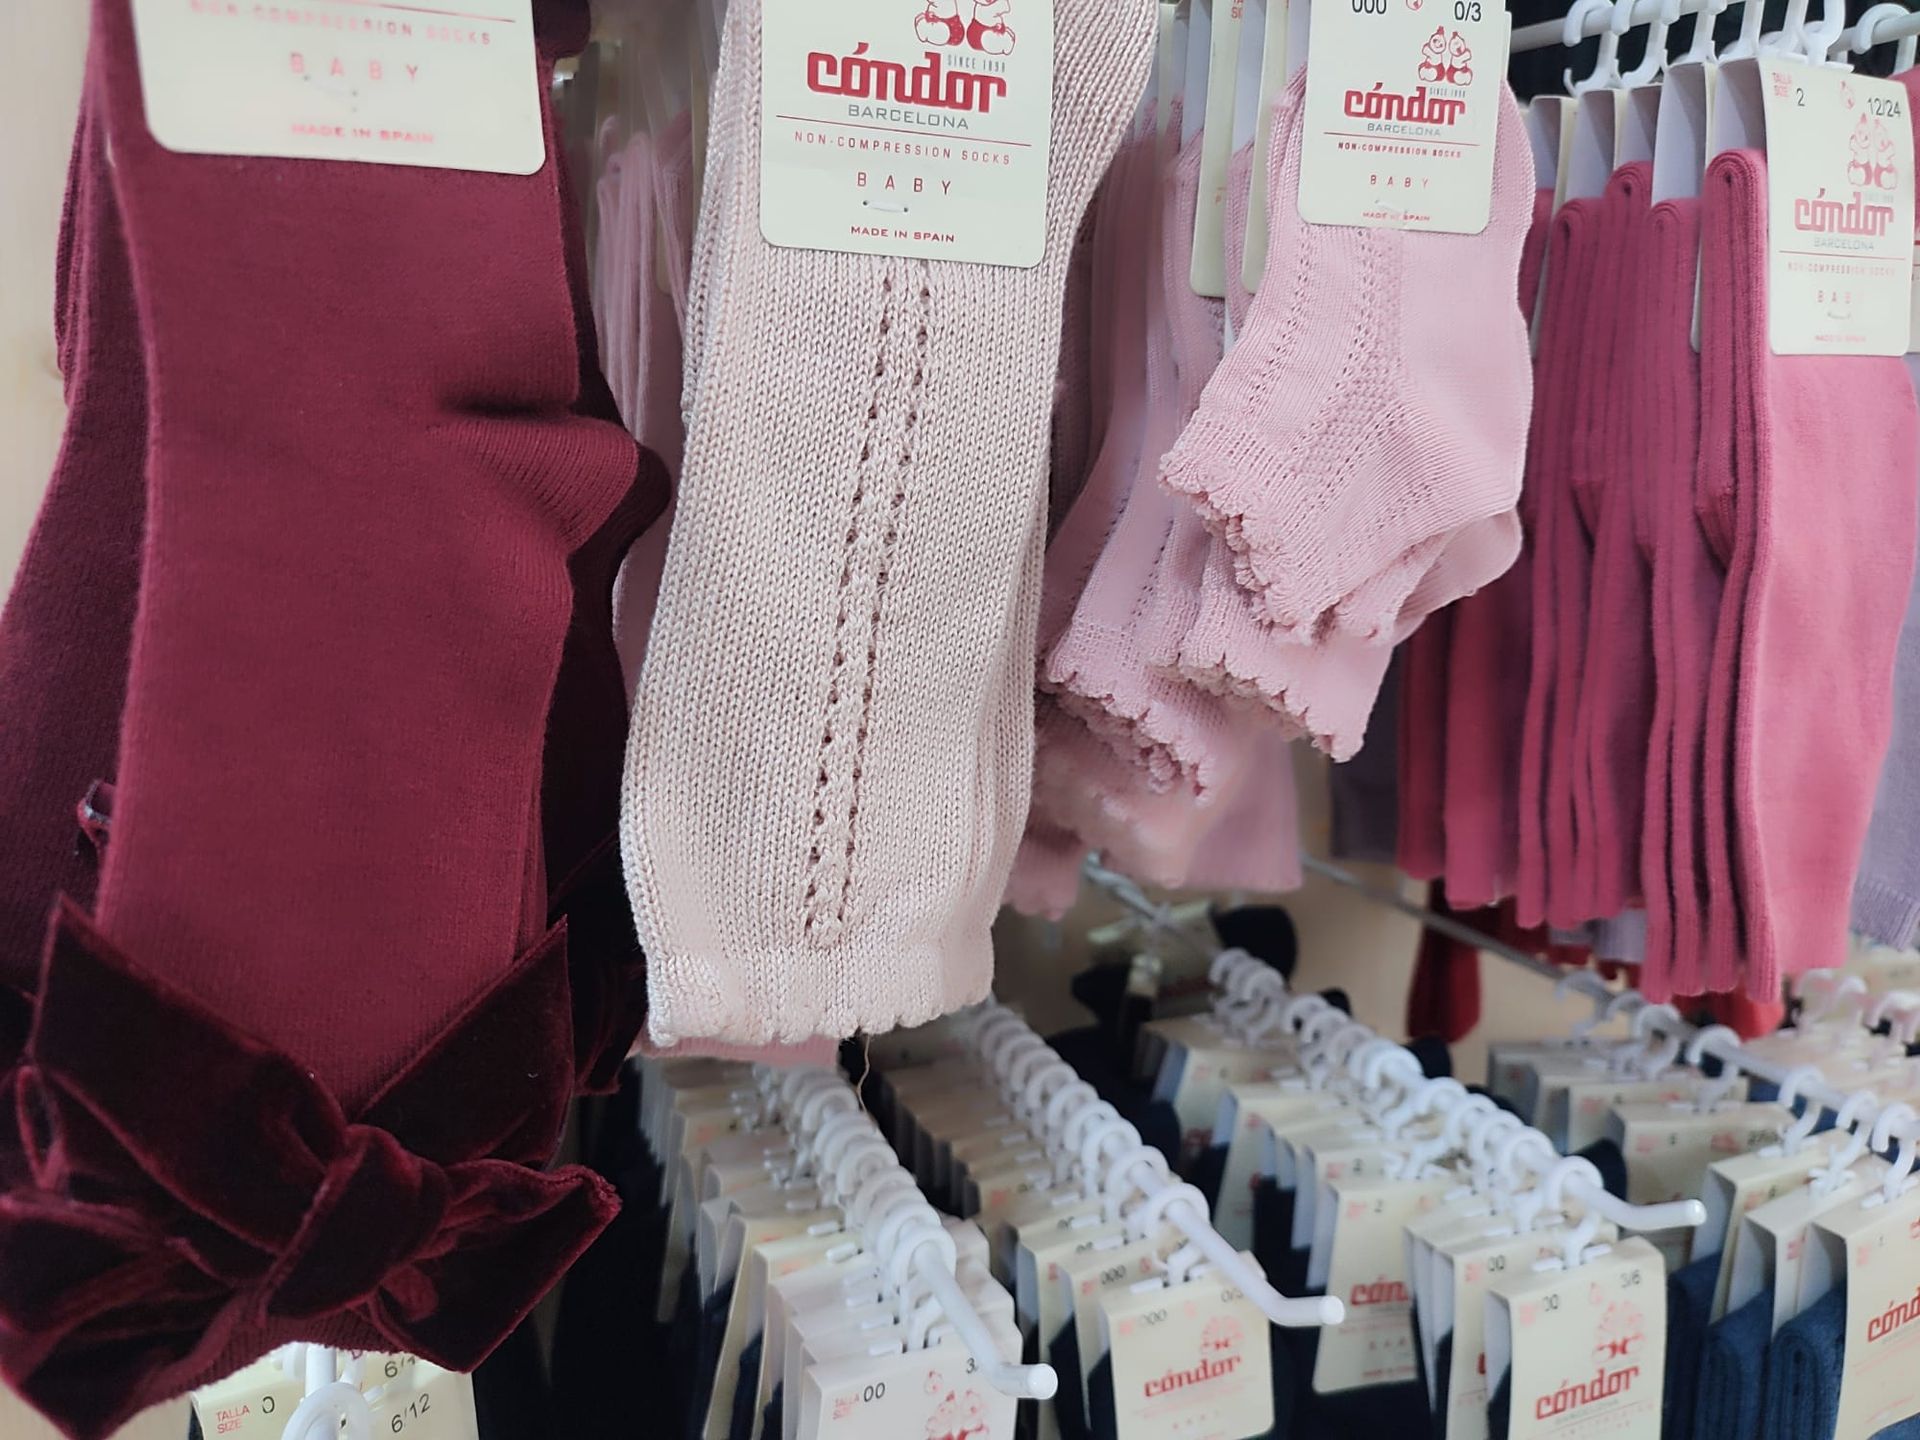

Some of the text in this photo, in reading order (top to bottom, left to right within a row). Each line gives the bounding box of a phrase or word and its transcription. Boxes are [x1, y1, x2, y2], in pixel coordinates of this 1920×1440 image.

[1454, 0, 1482, 22] 0/3
[806, 42, 1007, 113] cóndor
[1343, 82, 1466, 125] cóndor
[1796, 87, 1805, 107] 2
[848, 104, 969, 130] BARCELONA
[1367, 123, 1441, 137] BARCELONA
[961, 150, 1011, 165] SOCKS
[857, 172, 952, 195] BABY
[1370, 174, 1429, 189] BABY
[1795, 188, 1894, 237] cóndor
[850, 226, 955, 243] MADE IN SPAIN
[1144, 1354, 1241, 1397] cóndor
[863, 1382, 886, 1402] 00
[1536, 1365, 1640, 1420] cóndor
[216, 1404, 250, 1423] TALLA
[262, 1396, 275, 1414] 0
[391, 1393, 431, 1433] 6/12
[217, 1418, 242, 1434] SIZE
